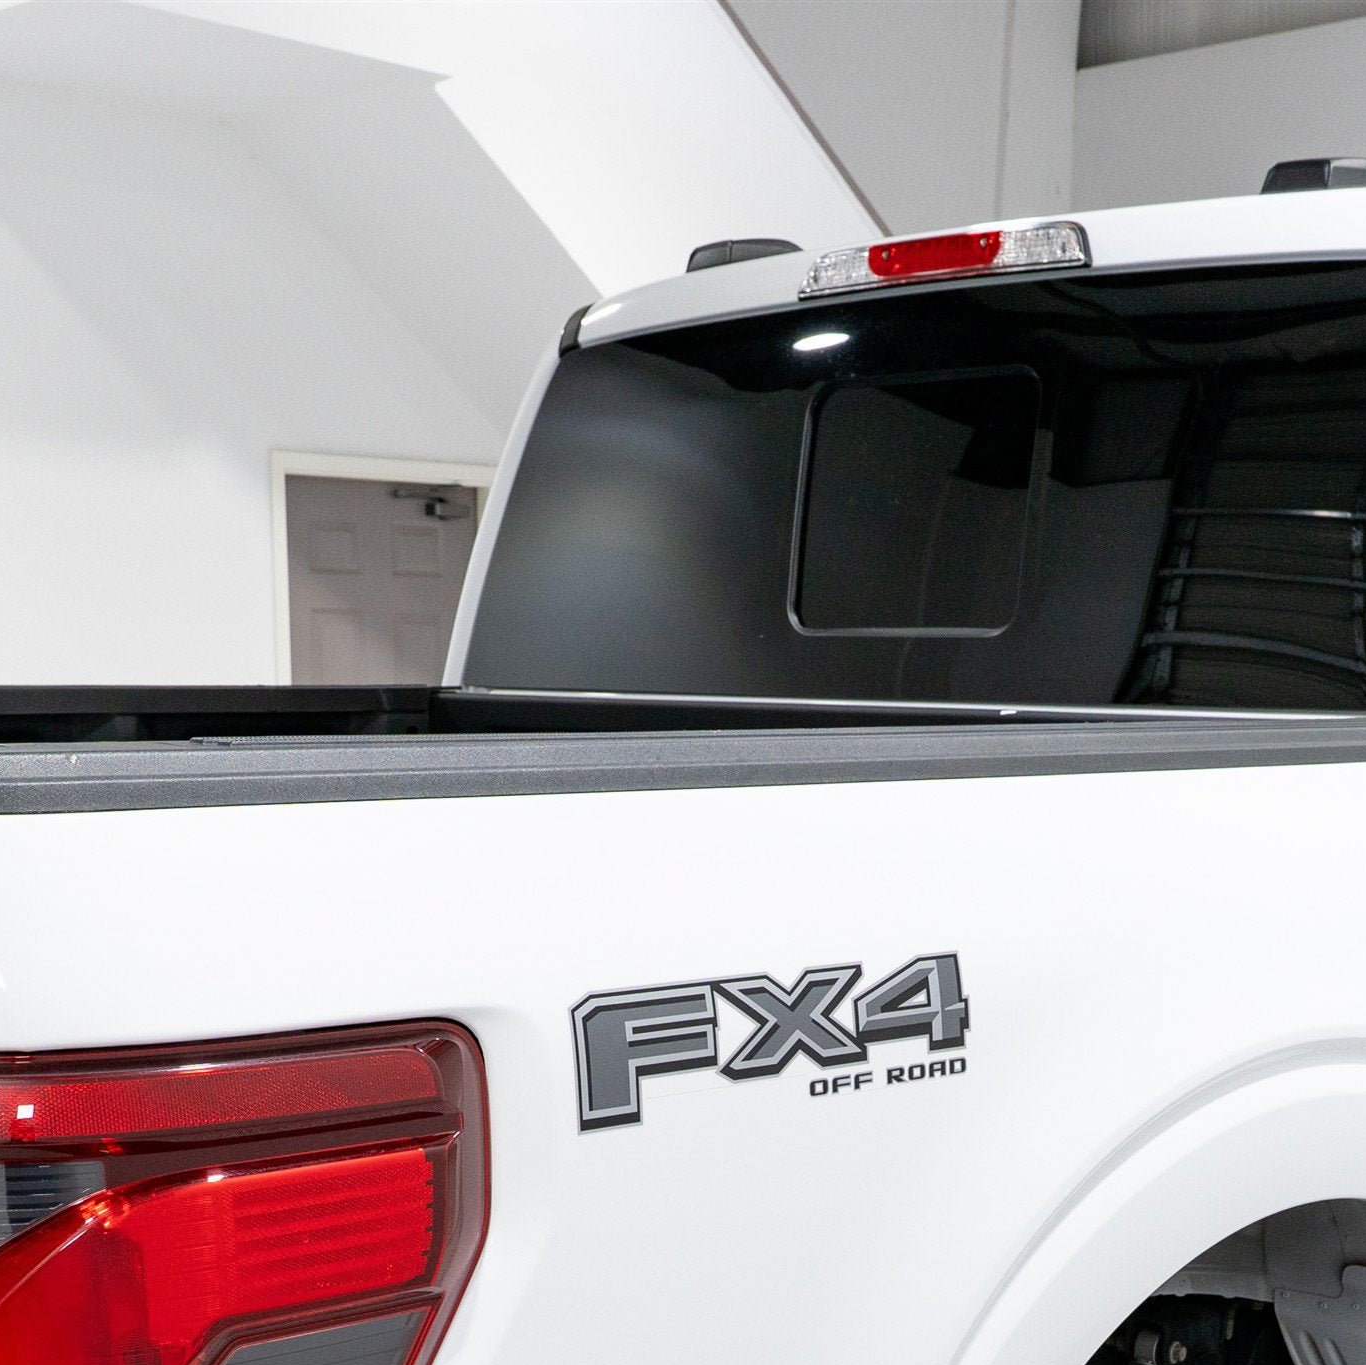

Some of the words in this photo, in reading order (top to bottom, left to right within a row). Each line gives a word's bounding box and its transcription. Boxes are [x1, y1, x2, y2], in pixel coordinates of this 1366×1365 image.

[569, 950, 970, 1135] FX4
[809, 1070, 874, 1098] OFF
[886, 1057, 968, 1086] ROAD
